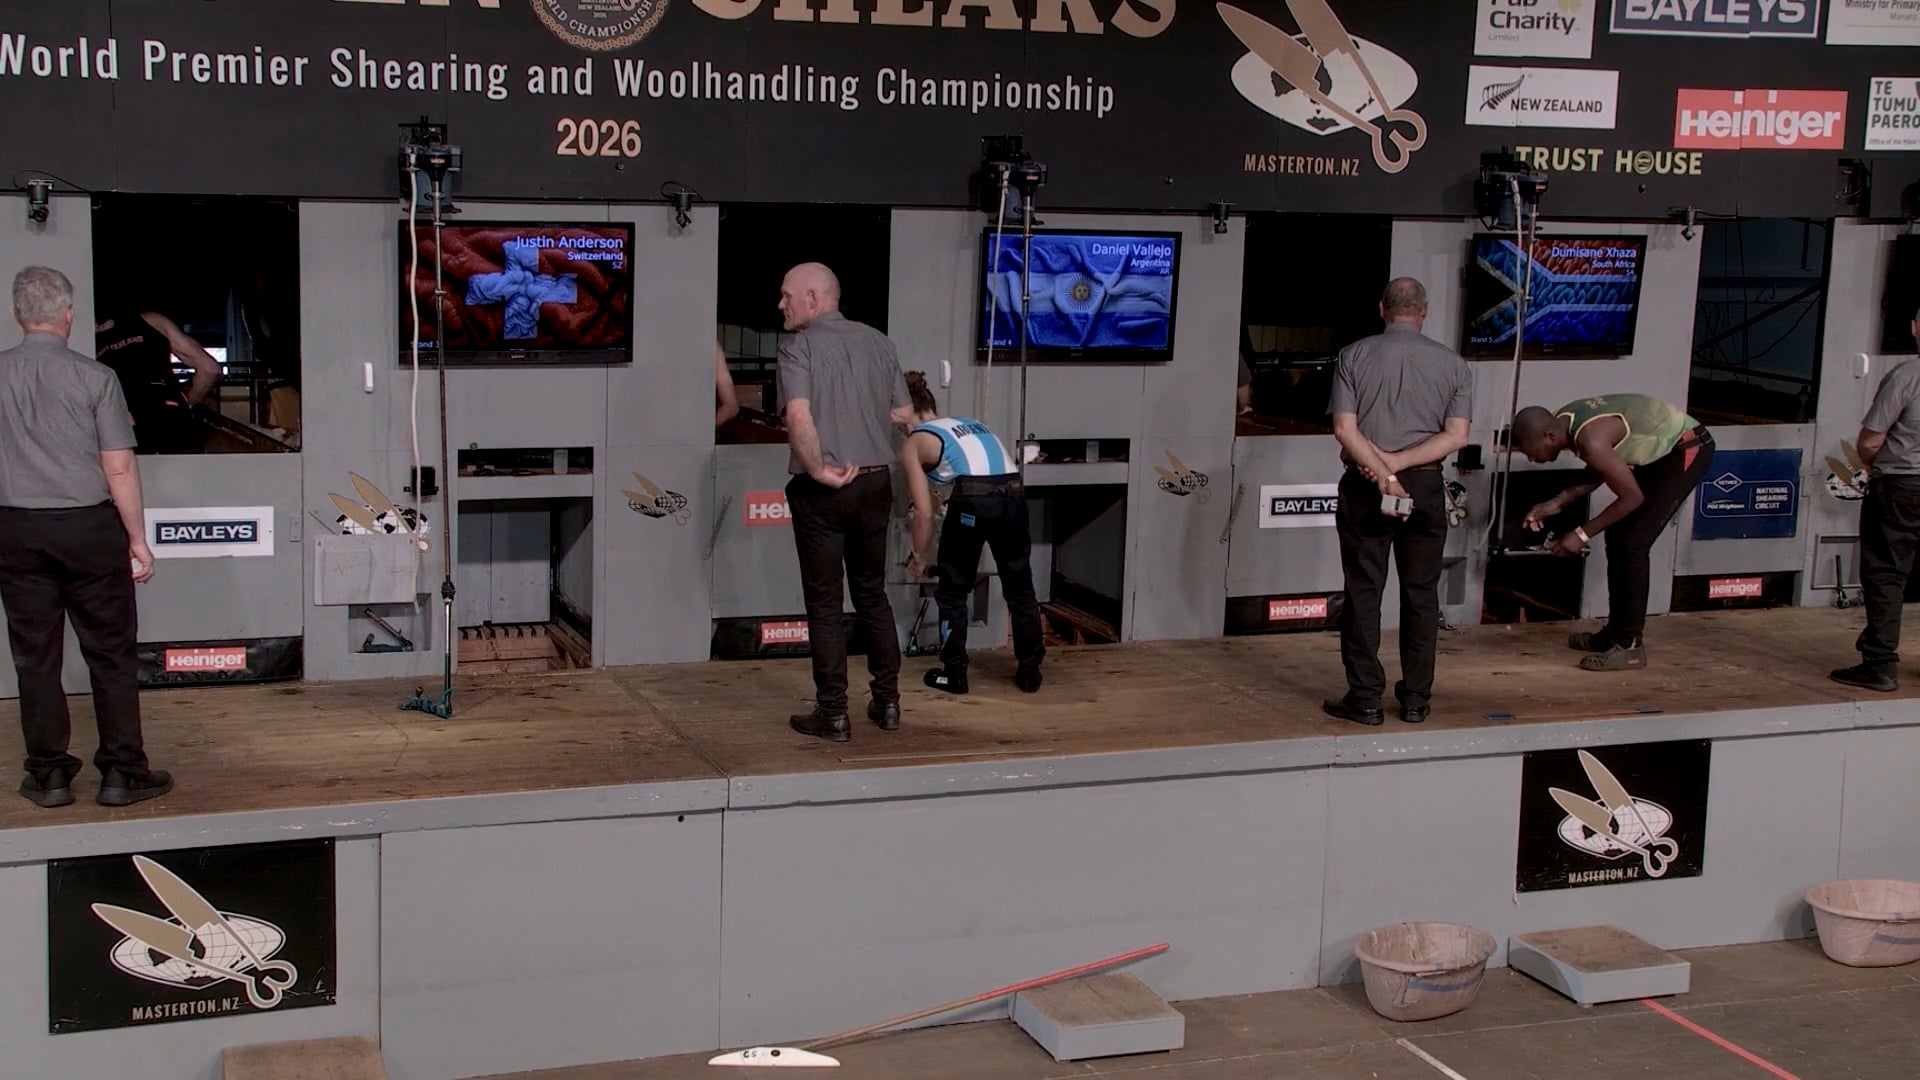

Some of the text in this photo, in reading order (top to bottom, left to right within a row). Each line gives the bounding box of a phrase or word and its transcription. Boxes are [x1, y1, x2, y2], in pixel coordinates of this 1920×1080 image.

[1489, 10, 1576, 36] Charity
[1488, 32, 1520, 41] Limited
[0, 33, 1115, 119] World Premier Shearing and Woolhandling Championship
[1875, 80, 1893, 95] TE
[1511, 98, 1603, 113] NEW ZEALAND
[1873, 97, 1917, 112] TUMU
[1680, 90, 1841, 145] Heiniger
[556, 118, 642, 158] 2026
[1244, 154, 1361, 177] MASTERTON.NZ
[1515, 145, 1703, 176] TRUST HOUSE
[515, 235, 623, 250] Justin Anderson
[567, 251, 623, 261] Switzerland
[1092, 243, 1172, 258] Daniel Vallejo
[1551, 247, 1637, 258] Dumisane Xhaza
[1130, 258, 1170, 269] Argentina
[1592, 261, 1636, 269] South Africa
[1755, 494, 1788, 502] SHEARING
[1755, 502, 1780, 510] CIRCUIT
[160, 524, 253, 541] BAYLEYS
[1710, 578, 1760, 594] Heiniger
[1269, 599, 1325, 617] Heiniger
[169, 648, 245, 668] Heiniger
[1568, 867, 1639, 883] MASTERTON.NZ
[132, 996, 241, 1021] MASTERTON.NZ
